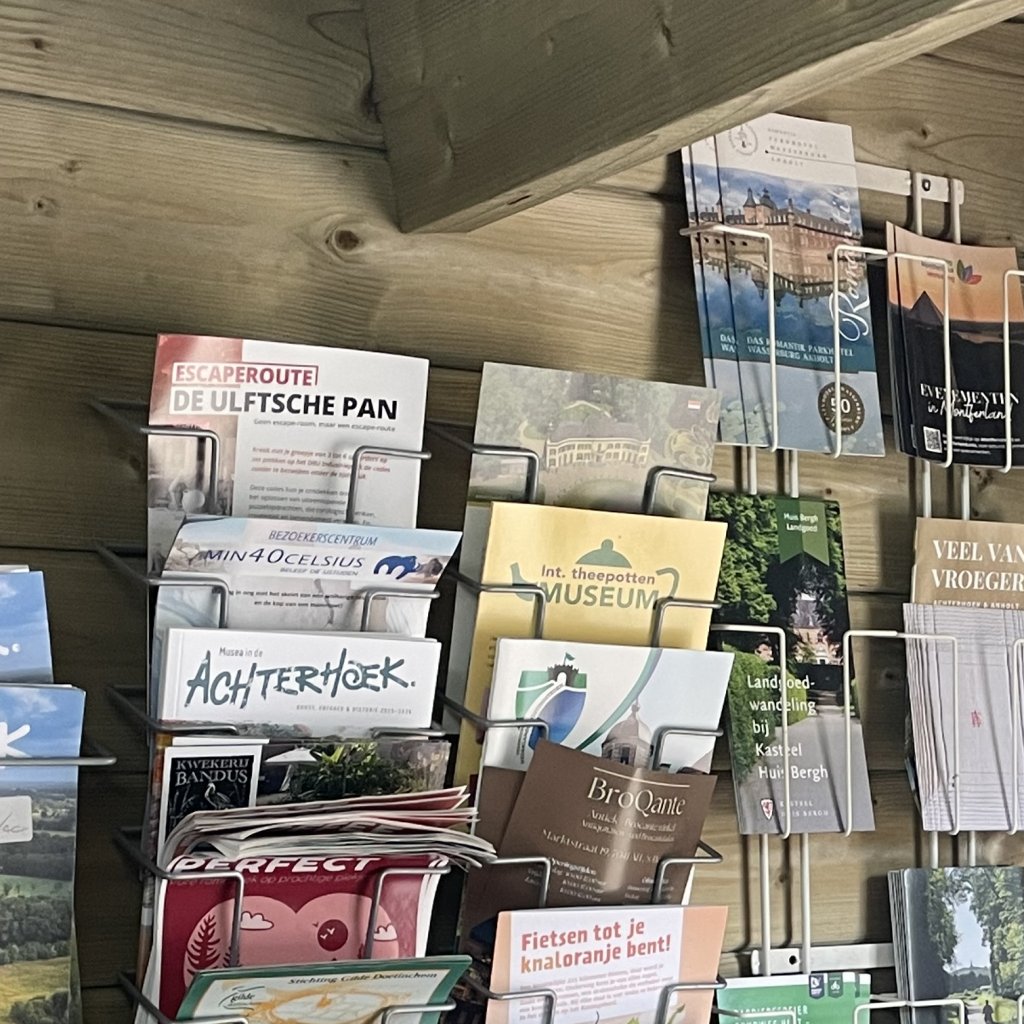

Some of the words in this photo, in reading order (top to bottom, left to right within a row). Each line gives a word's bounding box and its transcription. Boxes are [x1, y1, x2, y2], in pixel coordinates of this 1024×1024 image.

[174, 364, 314, 387] ESCAPEROUTE
[172, 389, 205, 412] DE
[210, 390, 335, 417] ULFTSCHE
[342, 397, 398, 420] PAN
[268, 530, 378, 546] BEZOEKERSCENTRUM
[932, 539, 983, 562] VEEL
[541, 564, 566, 579] Int.
[572, 566, 656, 586] theepotten
[931, 568, 1024, 592] VROEGER
[544, 580, 660, 610] MUSEUM
[752, 719, 770, 738] bij
[176, 758, 249, 771] KWEKERIJ
[790, 764, 829, 783] Bergh
[175, 769, 249, 787] BANDUS
[587, 776, 686, 818] BroQante
[173, 856, 382, 874] PERFECT
[520, 928, 588, 952] Fietsen
[593, 921, 622, 942] tot
[627, 918, 645, 940] je
[520, 944, 621, 974] knaloranje
[626, 934, 671, 959] bent!
